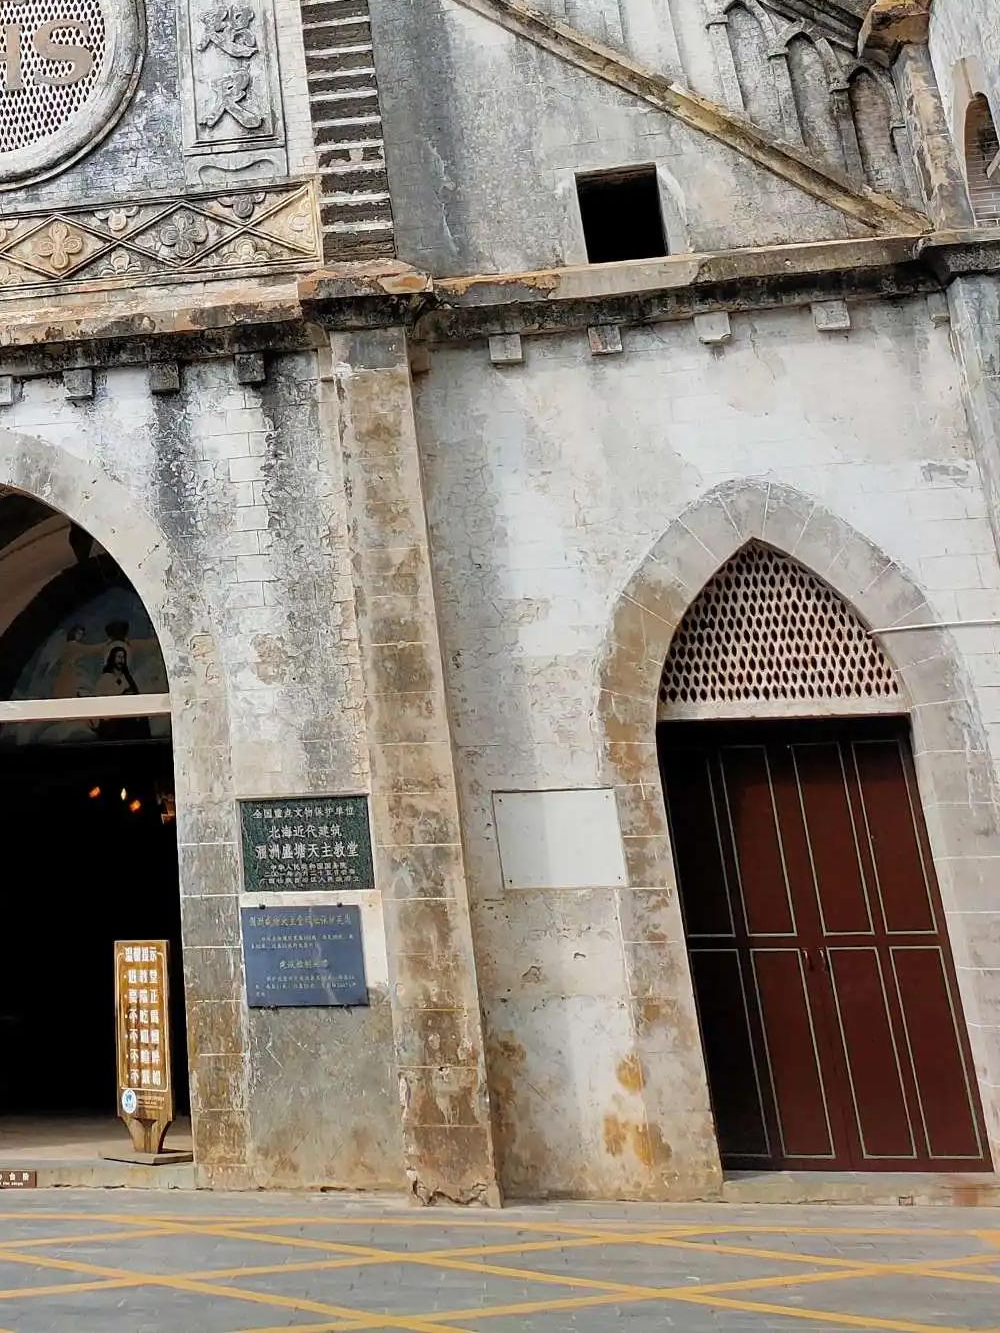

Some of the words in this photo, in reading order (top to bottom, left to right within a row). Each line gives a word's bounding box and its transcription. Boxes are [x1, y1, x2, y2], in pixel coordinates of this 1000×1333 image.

[253, 806, 354, 819] 全国重点文物保护单位
[268, 824, 342, 839] 北海近代建筑
